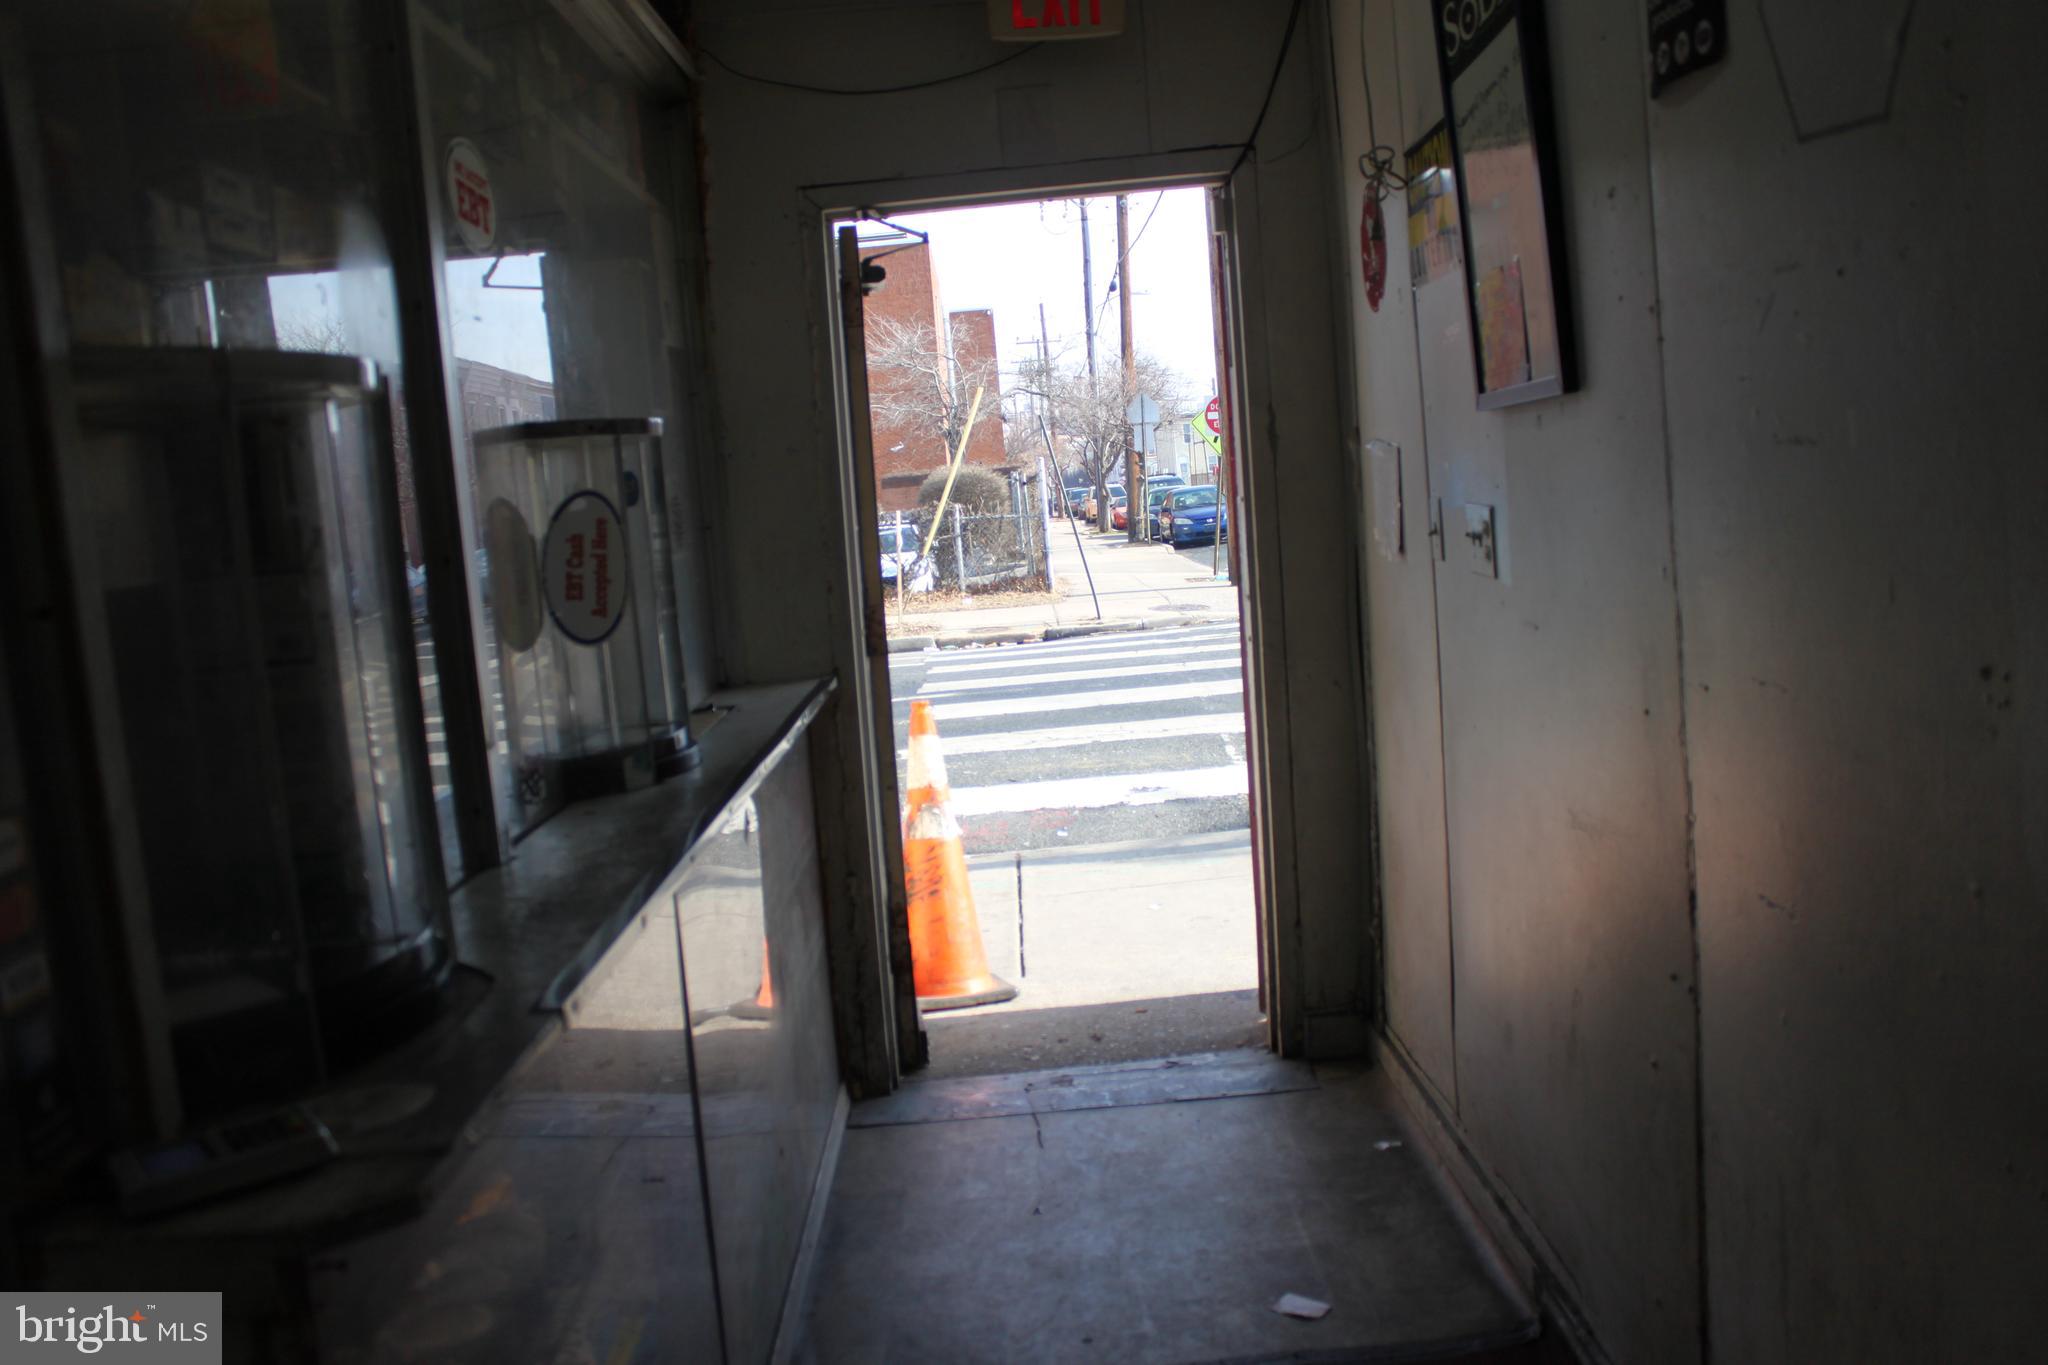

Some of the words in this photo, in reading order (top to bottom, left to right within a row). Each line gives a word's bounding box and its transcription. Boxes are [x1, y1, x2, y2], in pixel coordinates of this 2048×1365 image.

[455, 177, 491, 234] EBT
[565, 533, 584, 569] Cash
[592, 517, 607, 550] Here
[565, 572, 584, 602] EBT
[590, 553, 612, 618] Accepted
